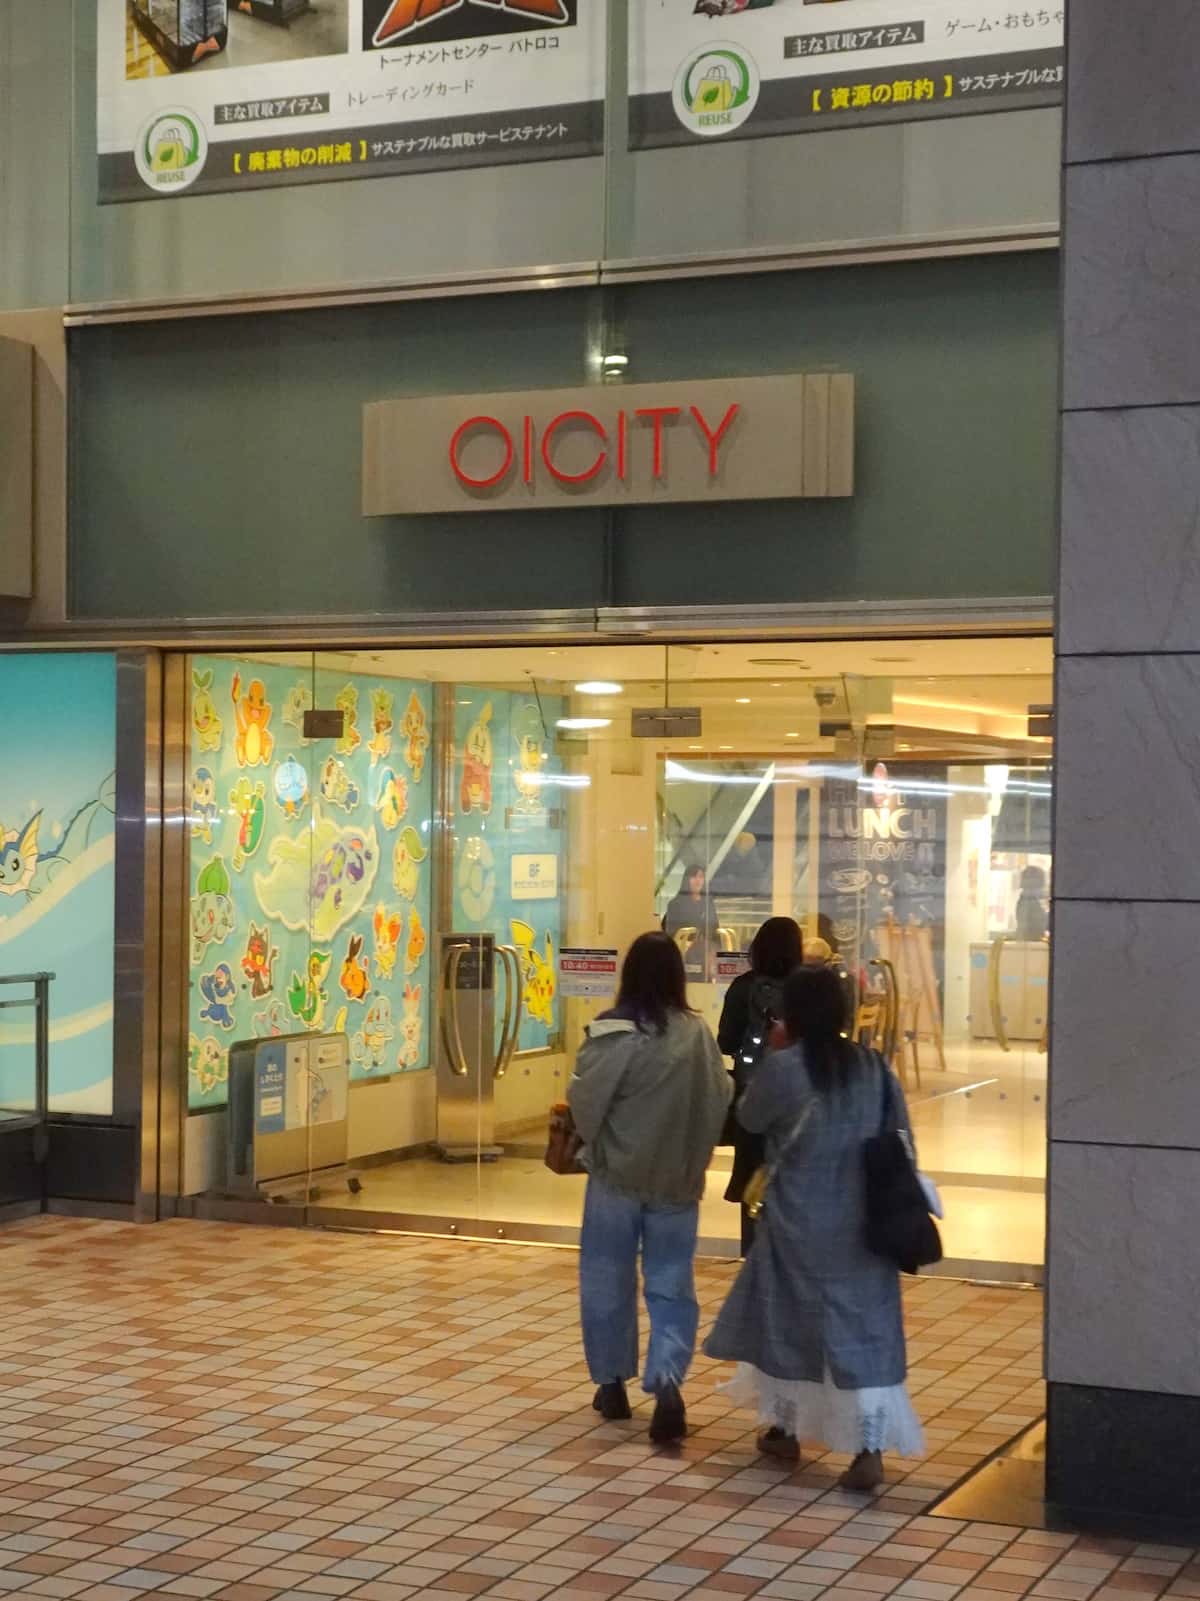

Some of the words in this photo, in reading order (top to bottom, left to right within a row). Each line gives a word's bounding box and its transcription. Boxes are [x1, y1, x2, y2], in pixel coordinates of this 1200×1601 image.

[380, 44, 502, 70] トーナメントセンター
[509, 36, 560, 54] バトロコ
[793, 26, 917, 55] 主な買取アイテム
[347, 79, 475, 107] トレーディングカード
[222, 97, 324, 122] 主な買取アイテム
[698, 112, 733, 127] REUSE
[155, 170, 186, 185] REUSE
[828, 807, 937, 839] LUNCH
